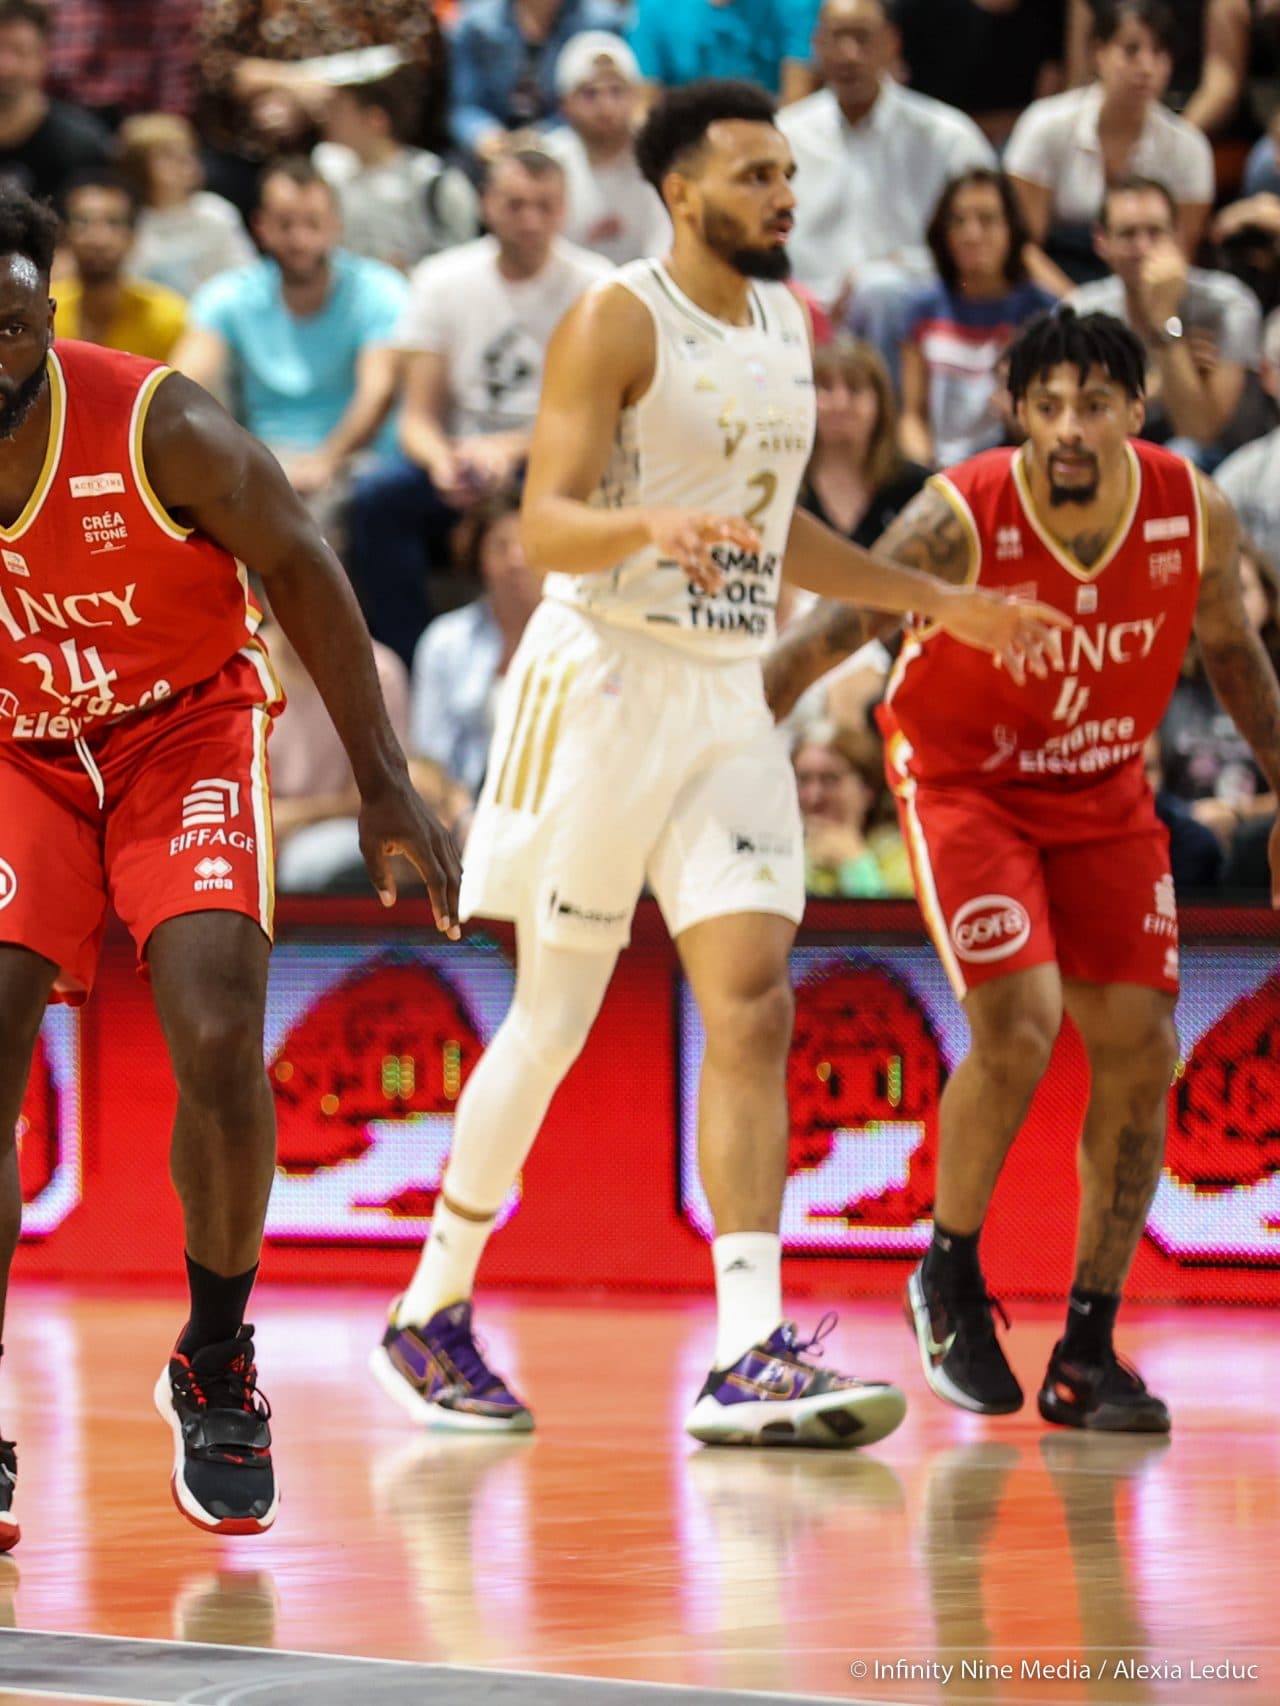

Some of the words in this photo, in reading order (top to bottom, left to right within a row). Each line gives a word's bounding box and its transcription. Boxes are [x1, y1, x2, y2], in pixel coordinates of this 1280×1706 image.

[744, 471, 778, 536] 2
[82, 511, 125, 530] CRÉA
[84, 526, 128, 543] STONE
[169, 828, 254, 857] EIFFAGE
[956, 910, 1022, 949] cora
